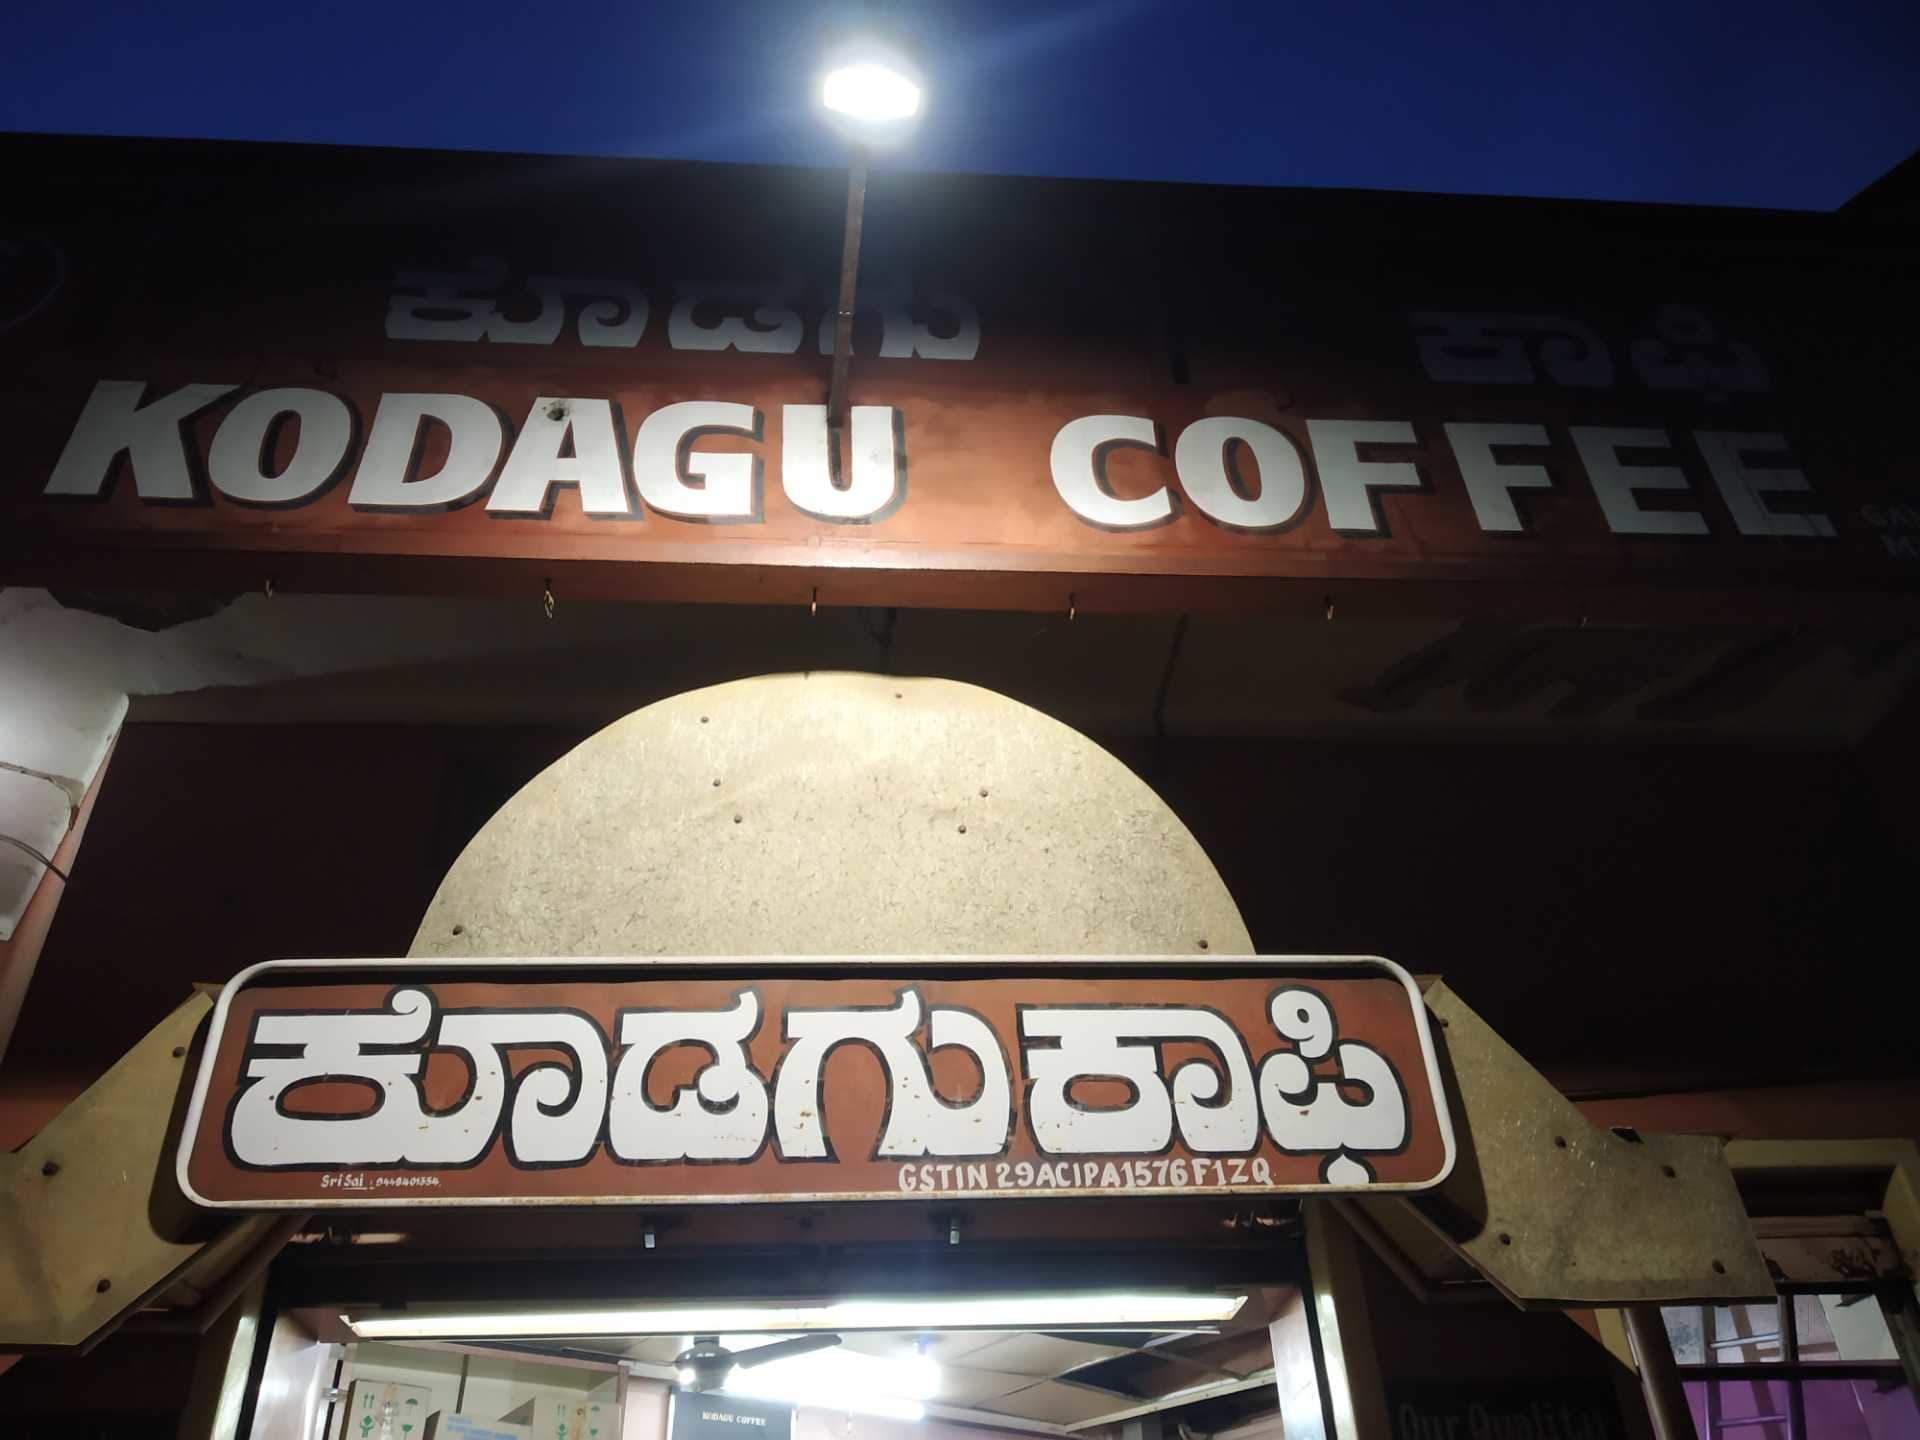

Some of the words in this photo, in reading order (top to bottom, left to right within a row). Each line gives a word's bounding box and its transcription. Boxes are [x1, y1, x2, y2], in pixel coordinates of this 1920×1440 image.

[43, 380, 904, 522] KODAGU
[1049, 413, 1838, 537] COFFEE
[897, 1162, 989, 1192] GSTIN
